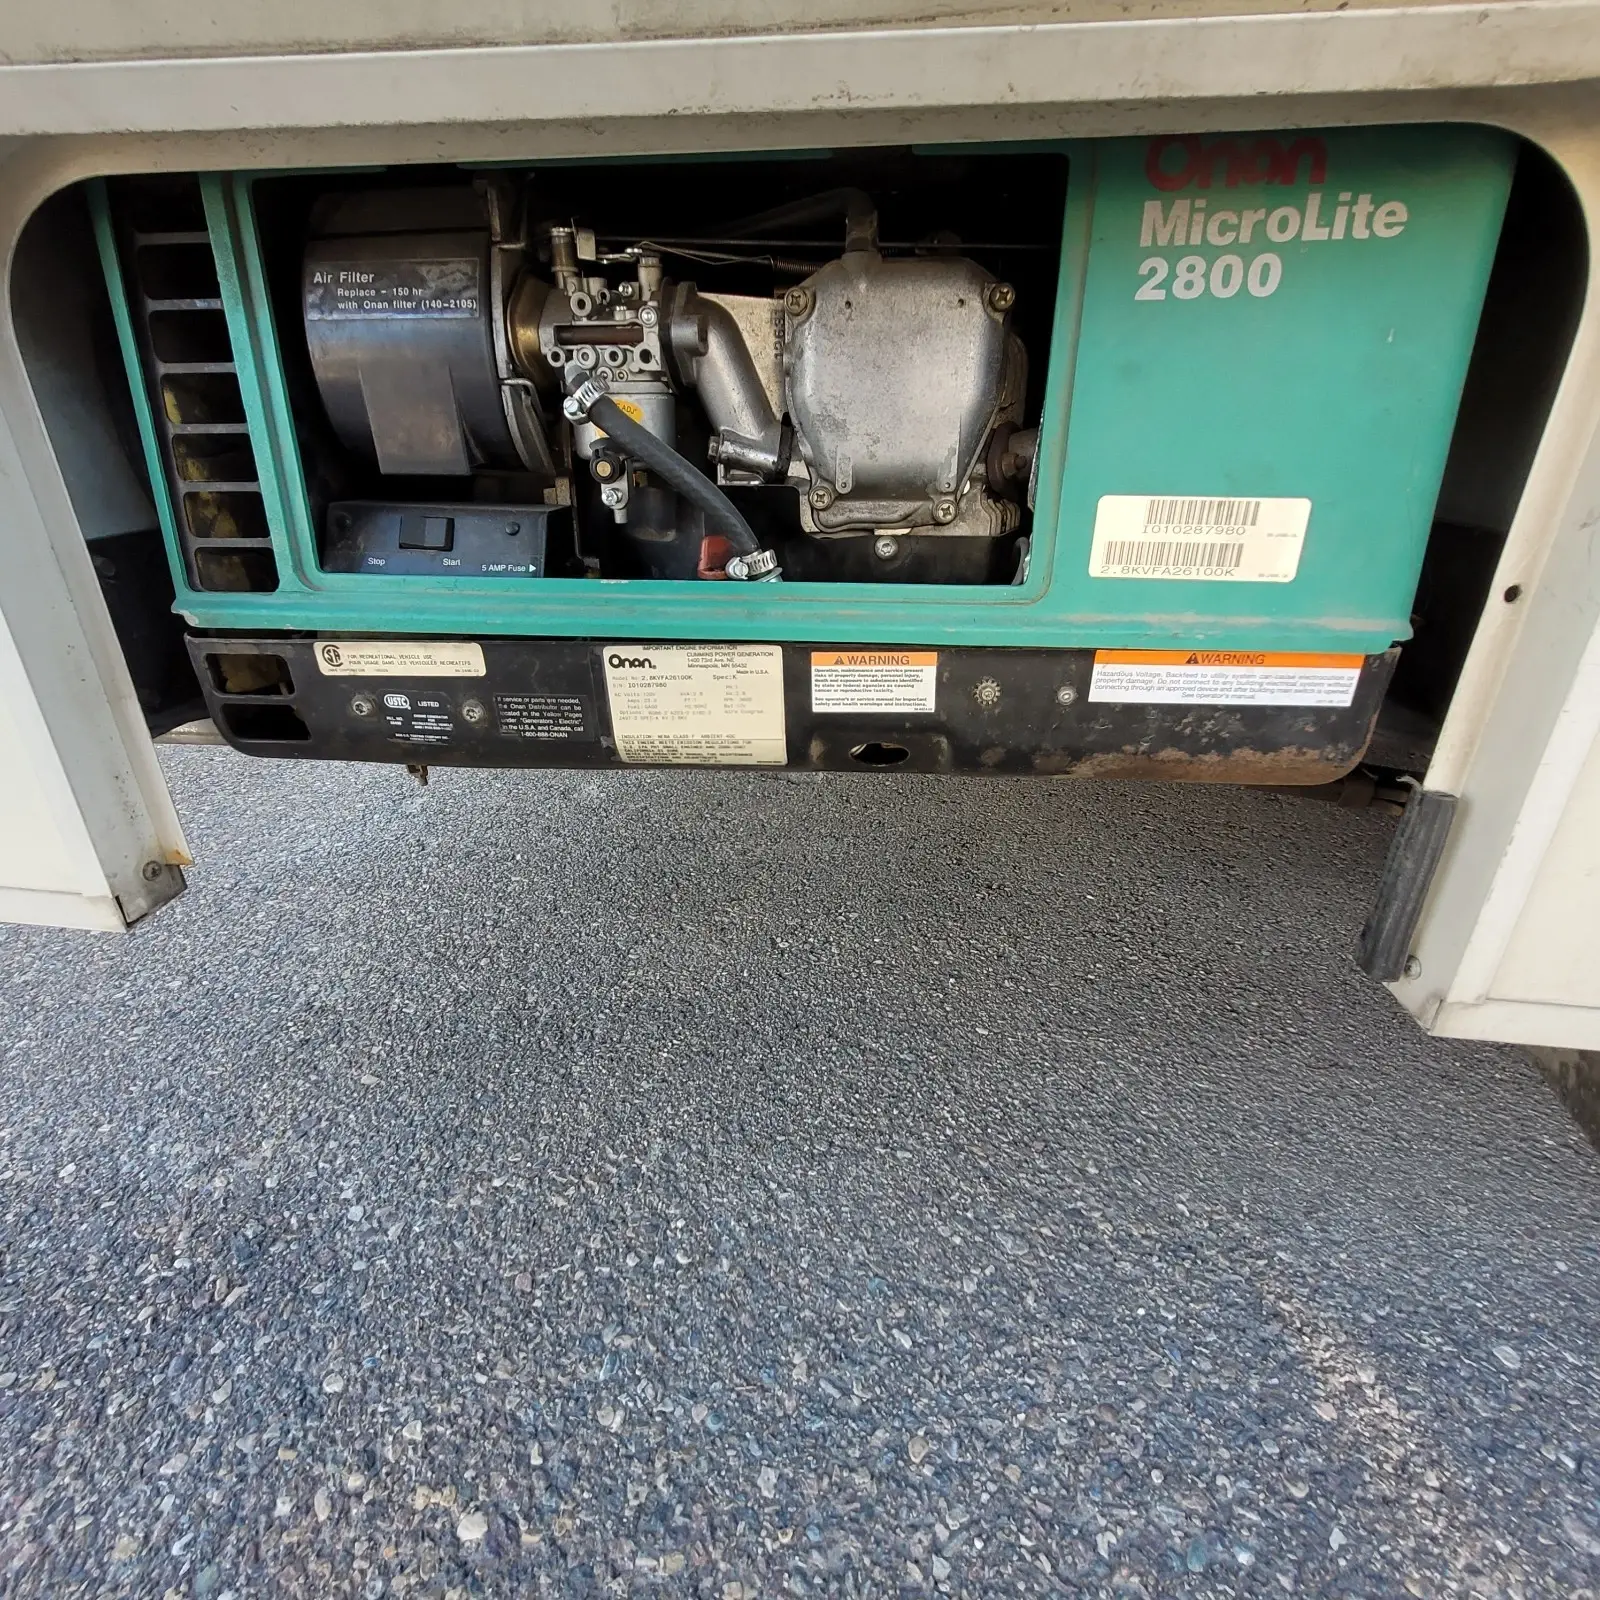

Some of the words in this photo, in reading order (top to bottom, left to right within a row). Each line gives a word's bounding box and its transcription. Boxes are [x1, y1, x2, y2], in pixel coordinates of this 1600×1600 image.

[1145, 135, 1328, 192] Onan
[1139, 192, 1409, 248] MicroLite
[313, 271, 333, 284] Air
[339, 271, 375, 284] Filter
[1134, 253, 1283, 300] 2800
[337, 287, 376, 298] Replace
[392, 287, 410, 296] 150
[412, 287, 424, 296] hr
[337, 301, 358, 310] with
[363, 301, 389, 310] Onan
[393, 300, 417, 310] filter
[421, 299, 477, 310] (140-2105)
[367, 557, 386, 567] Stop
[442, 558, 461, 566] Start
[481, 564, 487, 572] 5
[488, 564, 506, 572] AMP
[1100, 565, 1236, 577] 2.8KVFA26100K
[847, 655, 910, 666] WARNING
[1200, 653, 1266, 665] WARNING
[387, 696, 407, 706] USTC
[417, 700, 440, 708] LISTED
